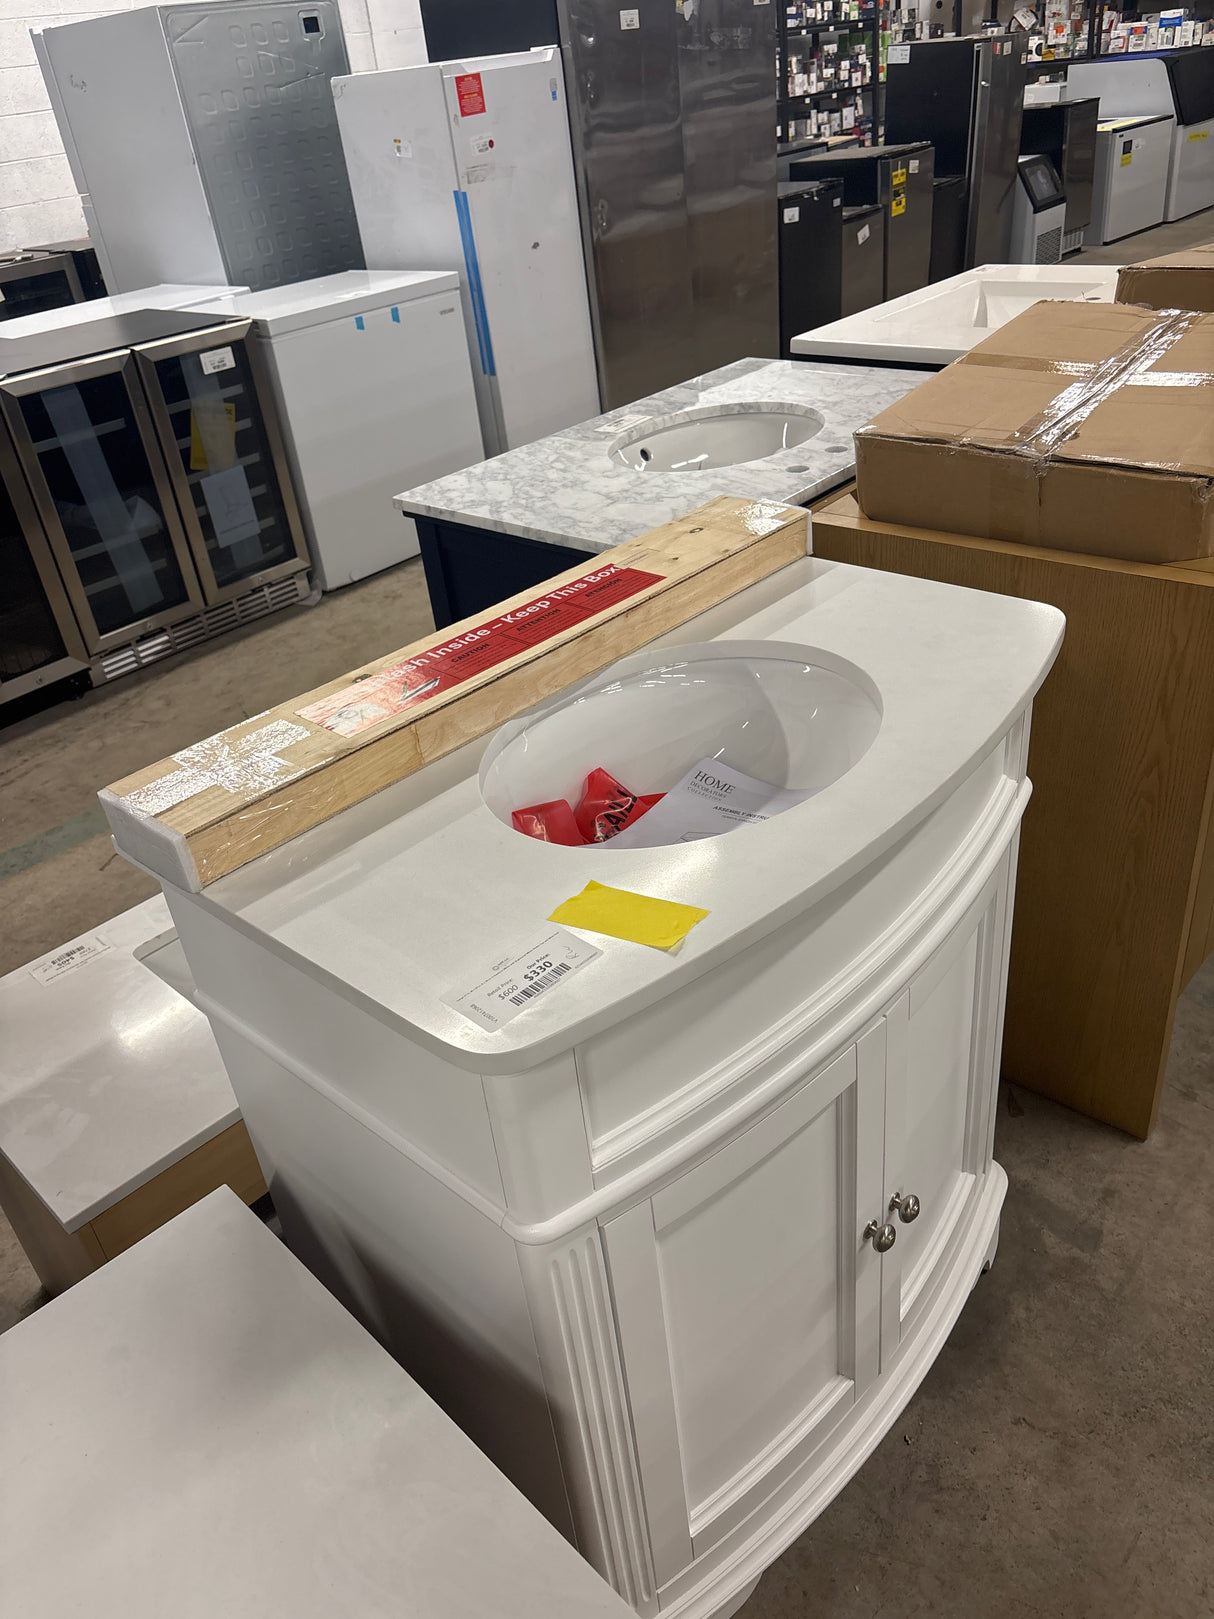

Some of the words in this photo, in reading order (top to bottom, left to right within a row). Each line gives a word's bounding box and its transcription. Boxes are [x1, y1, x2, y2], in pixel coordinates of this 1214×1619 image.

[427, 628, 491, 658] Inside
[501, 600, 550, 624] Keep
[546, 581, 588, 601] This
[516, 608, 561, 632] ATTENTION
[450, 643, 490, 663] CAUTION
[694, 770, 736, 794] HOME
[524, 961, 553, 982] $330
[498, 984, 519, 1001] $600
